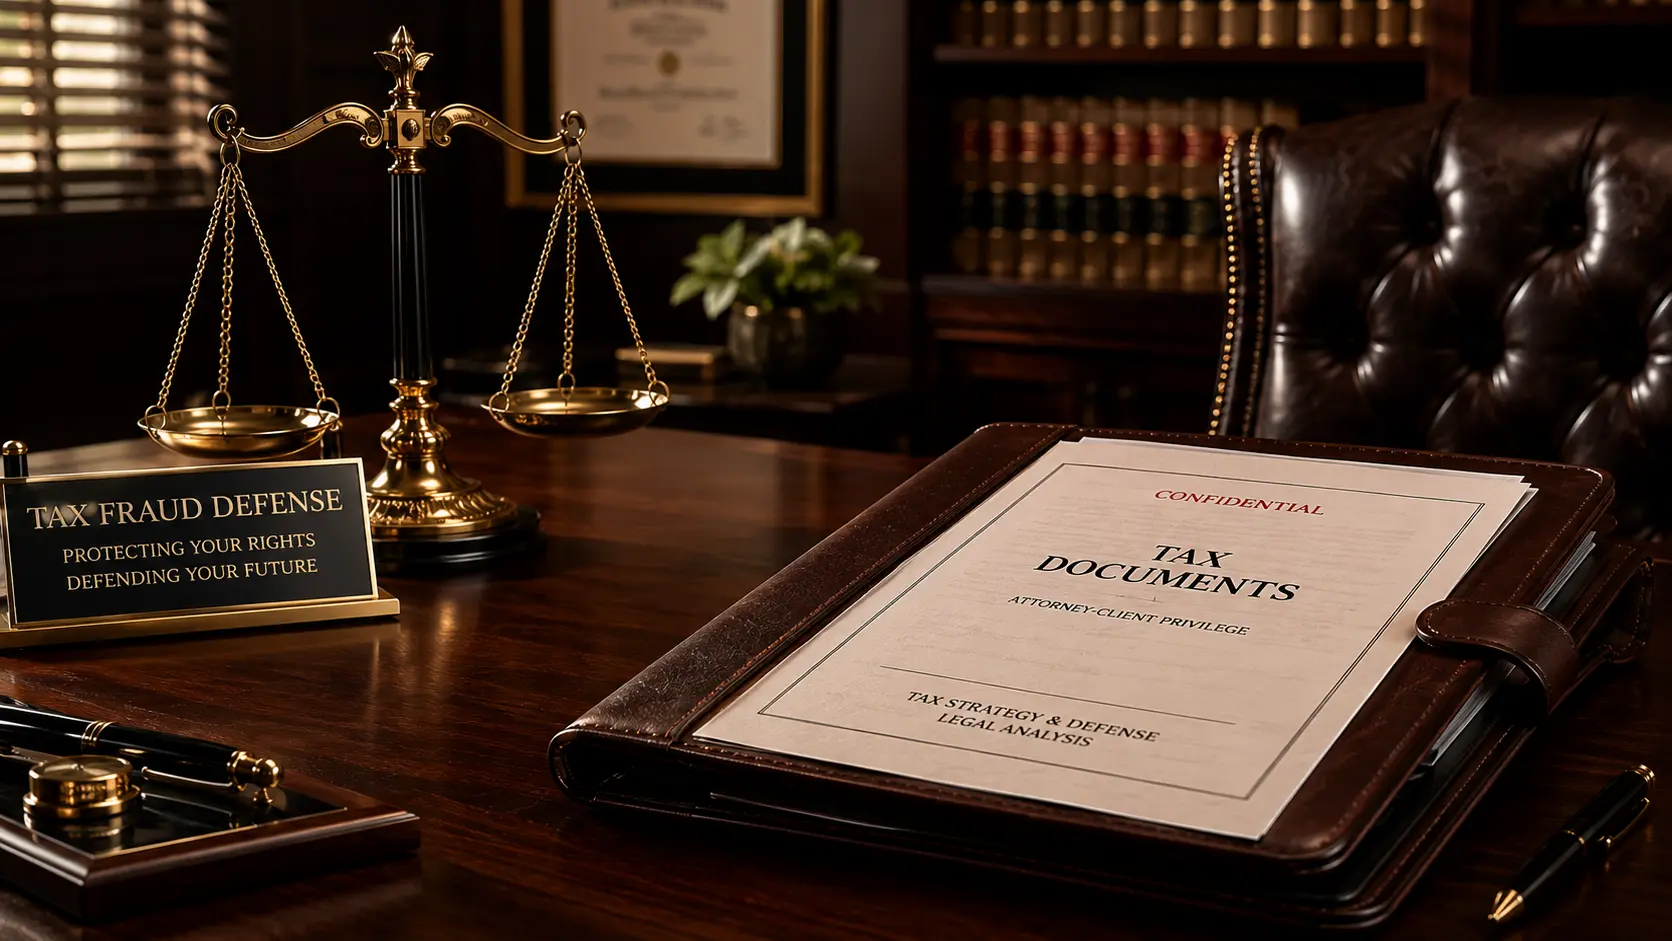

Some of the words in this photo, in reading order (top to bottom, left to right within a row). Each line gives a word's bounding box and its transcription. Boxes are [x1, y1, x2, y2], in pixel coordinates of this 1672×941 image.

[27, 503, 91, 530] TAX
[99, 497, 202, 526] FRAUD
[211, 488, 343, 518] DEFENSE
[1154, 489, 1325, 516] CONFIDENTIAL
[63, 540, 185, 564] PROTECTING
[190, 537, 242, 555] YOUR
[248, 532, 317, 551] RIGHTS
[1152, 544, 1234, 569] TAX
[67, 568, 181, 591] DEFENDING
[185, 562, 240, 581] YOUR
[244, 558, 319, 578] FUTURE
[1033, 554, 1301, 602] DOCUMENTS
[1007, 595, 1159, 624] ATTORNEY-CLIENT
[1159, 616, 1251, 636] PRIVILEGE
[906, 691, 944, 706] TAX
[945, 698, 1044, 723] STRATEGY
[1046, 715, 1062, 726] &
[1066, 718, 1161, 742] DEFENSE
[936, 713, 996, 732] LEGAL
[999, 724, 1094, 748] ANALYSIS
